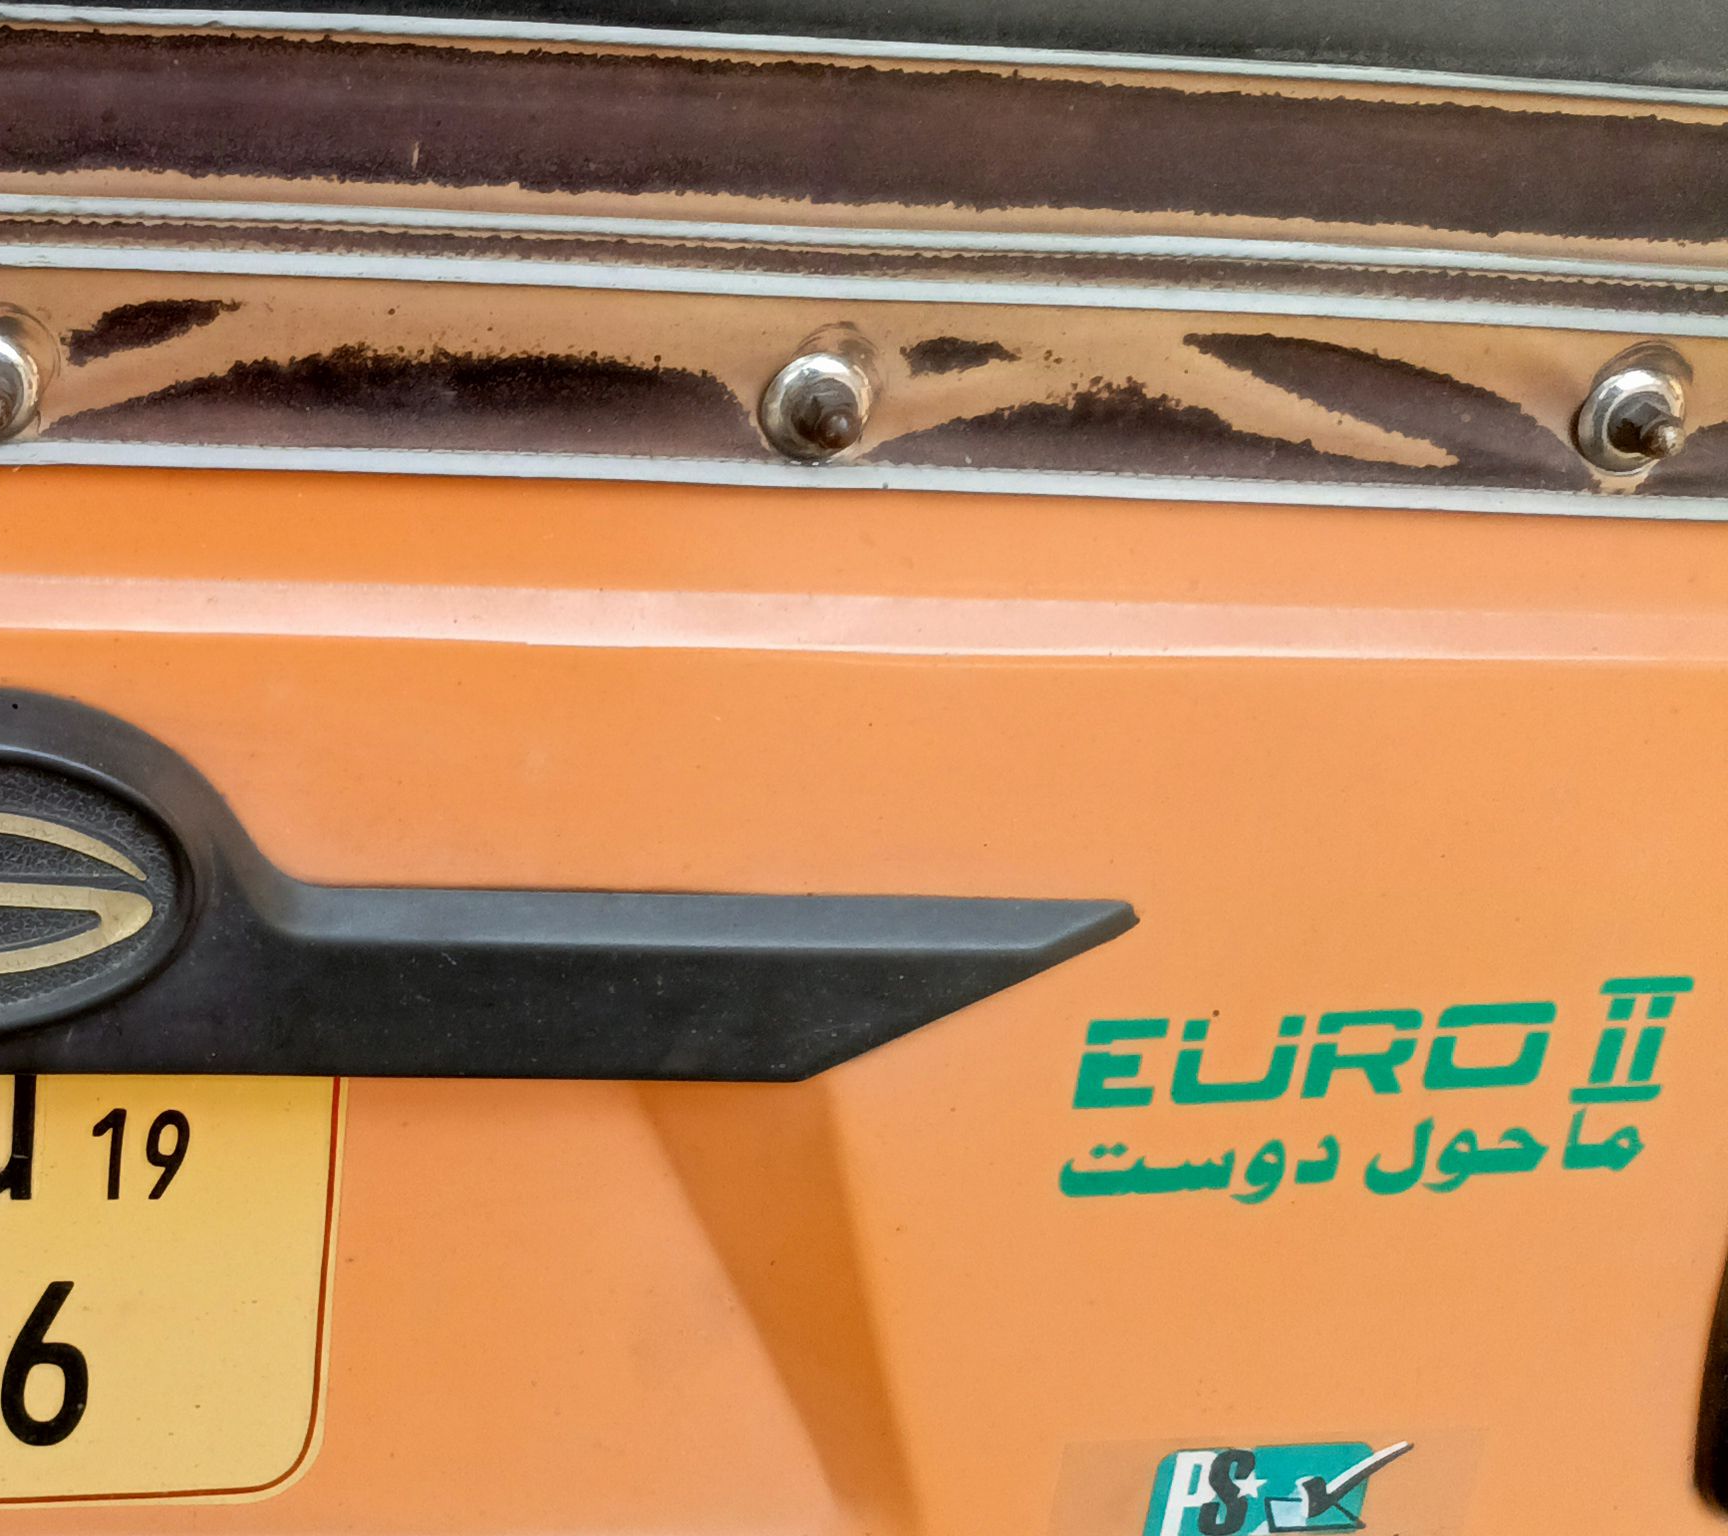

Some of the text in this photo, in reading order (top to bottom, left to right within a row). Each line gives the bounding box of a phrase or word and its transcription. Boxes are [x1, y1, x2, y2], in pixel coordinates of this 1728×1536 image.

[1072, 1001, 1557, 1109] EURO
[92, 1108, 192, 1201] 19
[1059, 1107, 1645, 1206] ماحول دوست
